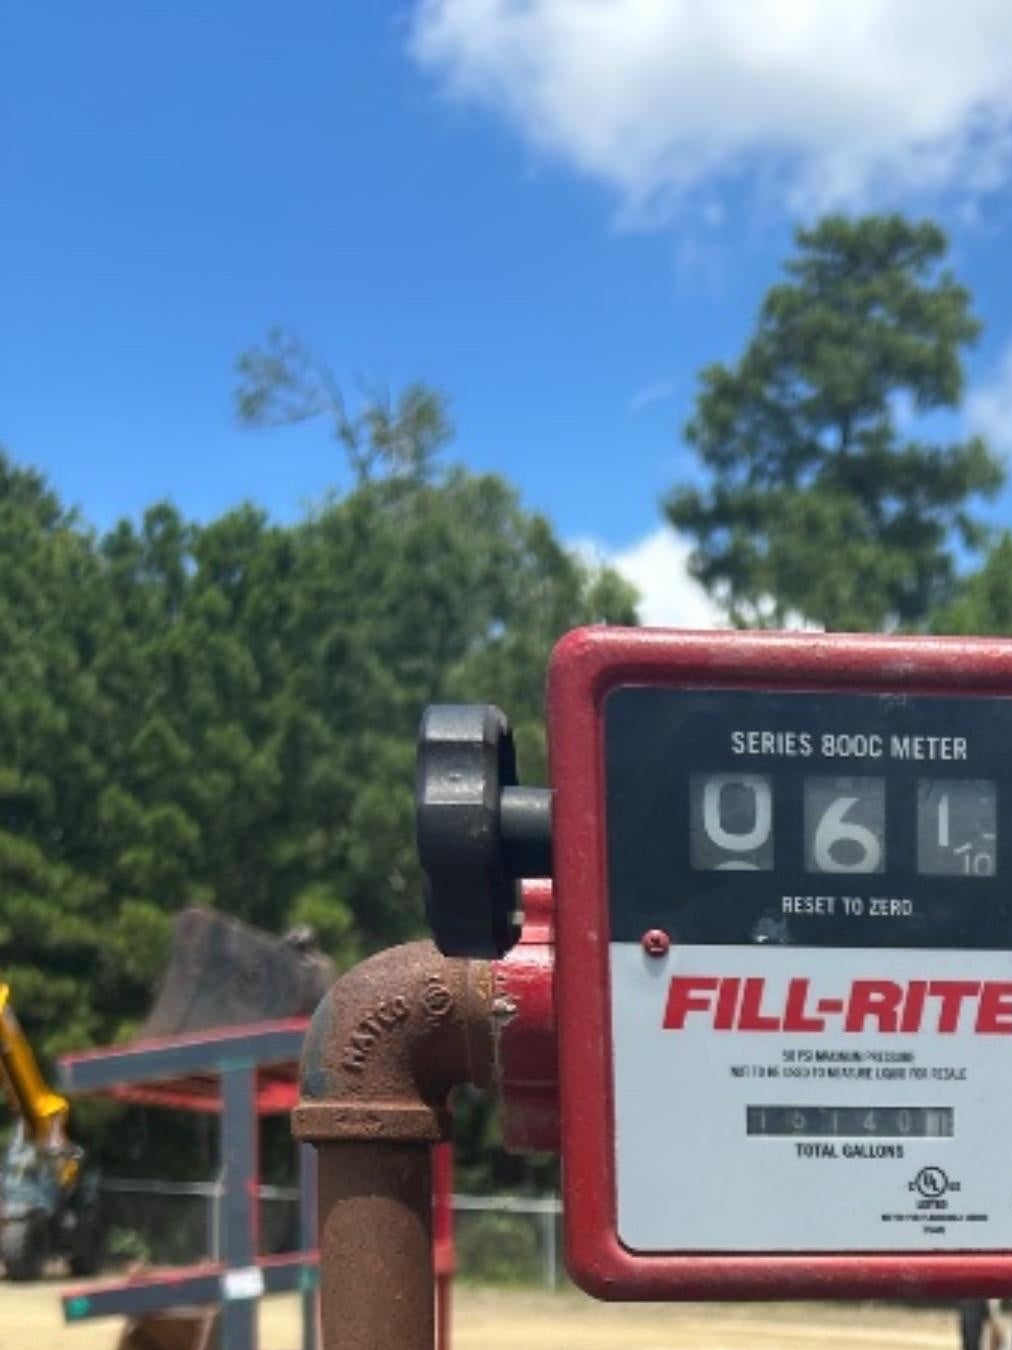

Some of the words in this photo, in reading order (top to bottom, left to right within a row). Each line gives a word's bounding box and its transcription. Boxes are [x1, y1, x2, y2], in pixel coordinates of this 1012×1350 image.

[731, 730, 813, 756] SERIES
[821, 734, 884, 759] 800C
[891, 736, 968, 761] METER
[782, 895, 836, 915] RESET
[841, 897, 864, 916] TO
[869, 898, 914, 917] ZERO
[795, 1142, 838, 1159] TOTAL
[842, 1143, 905, 1159] GALLONS
